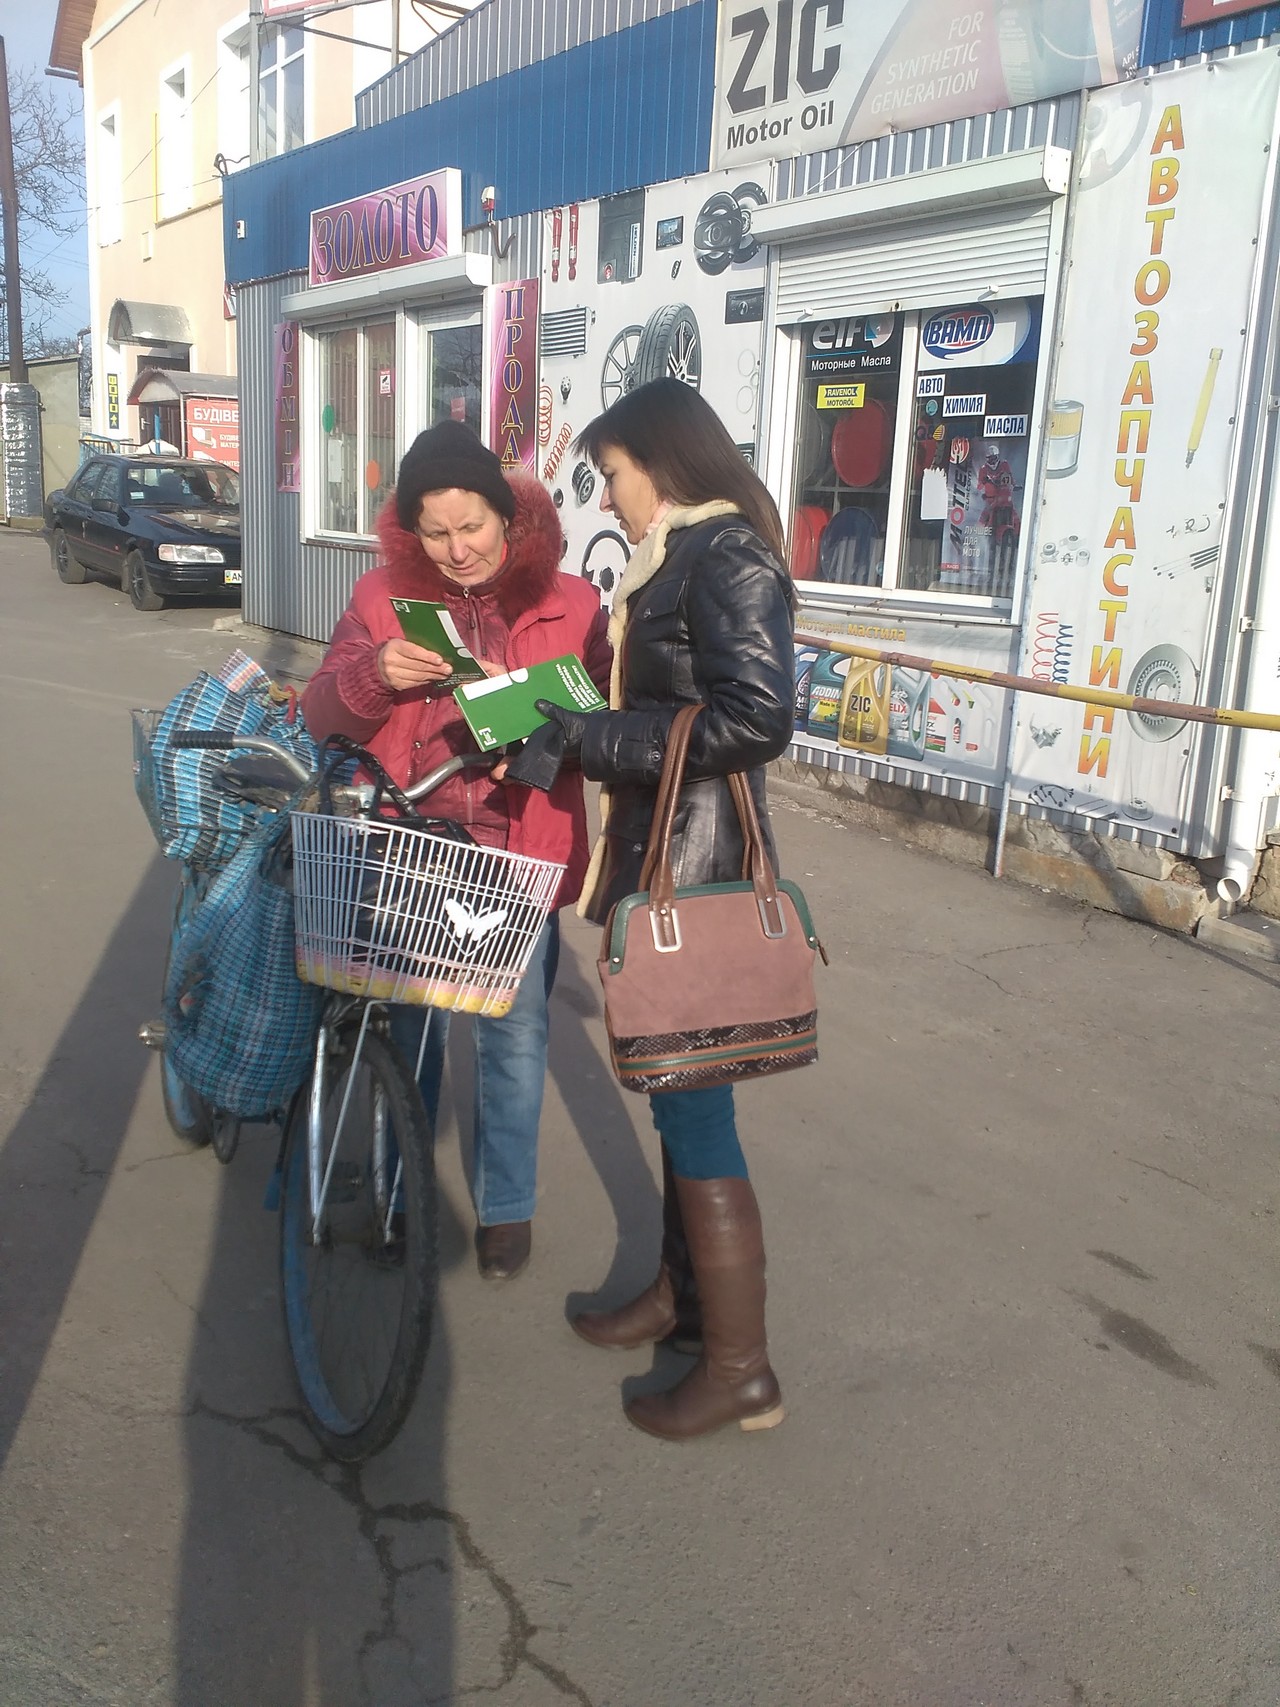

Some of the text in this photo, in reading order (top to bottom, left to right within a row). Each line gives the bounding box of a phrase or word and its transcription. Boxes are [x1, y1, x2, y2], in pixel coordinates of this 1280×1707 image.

[948, 12, 984, 39] FOR
[726, 0, 845, 115] ZIC
[886, 41, 980, 85] SYNTHETIC
[870, 68, 980, 115] GENERATION
[727, 100, 834, 149] Motor Oil
[316, 184, 438, 277] ЗОЛОТО
[811, 356, 891, 372] Моторные Масла
[501, 287, 525, 472] ПРОДА
[827, 388, 856, 397] RAVENOL
[918, 377, 943, 395] АВТО
[280, 327, 296, 488] ОБМІН
[945, 396, 983, 415] ХИМИЯ
[986, 417, 1024, 435] МАСЛА
[847, 623, 906, 642] мастила
[850, 695, 871, 713] ZIC
